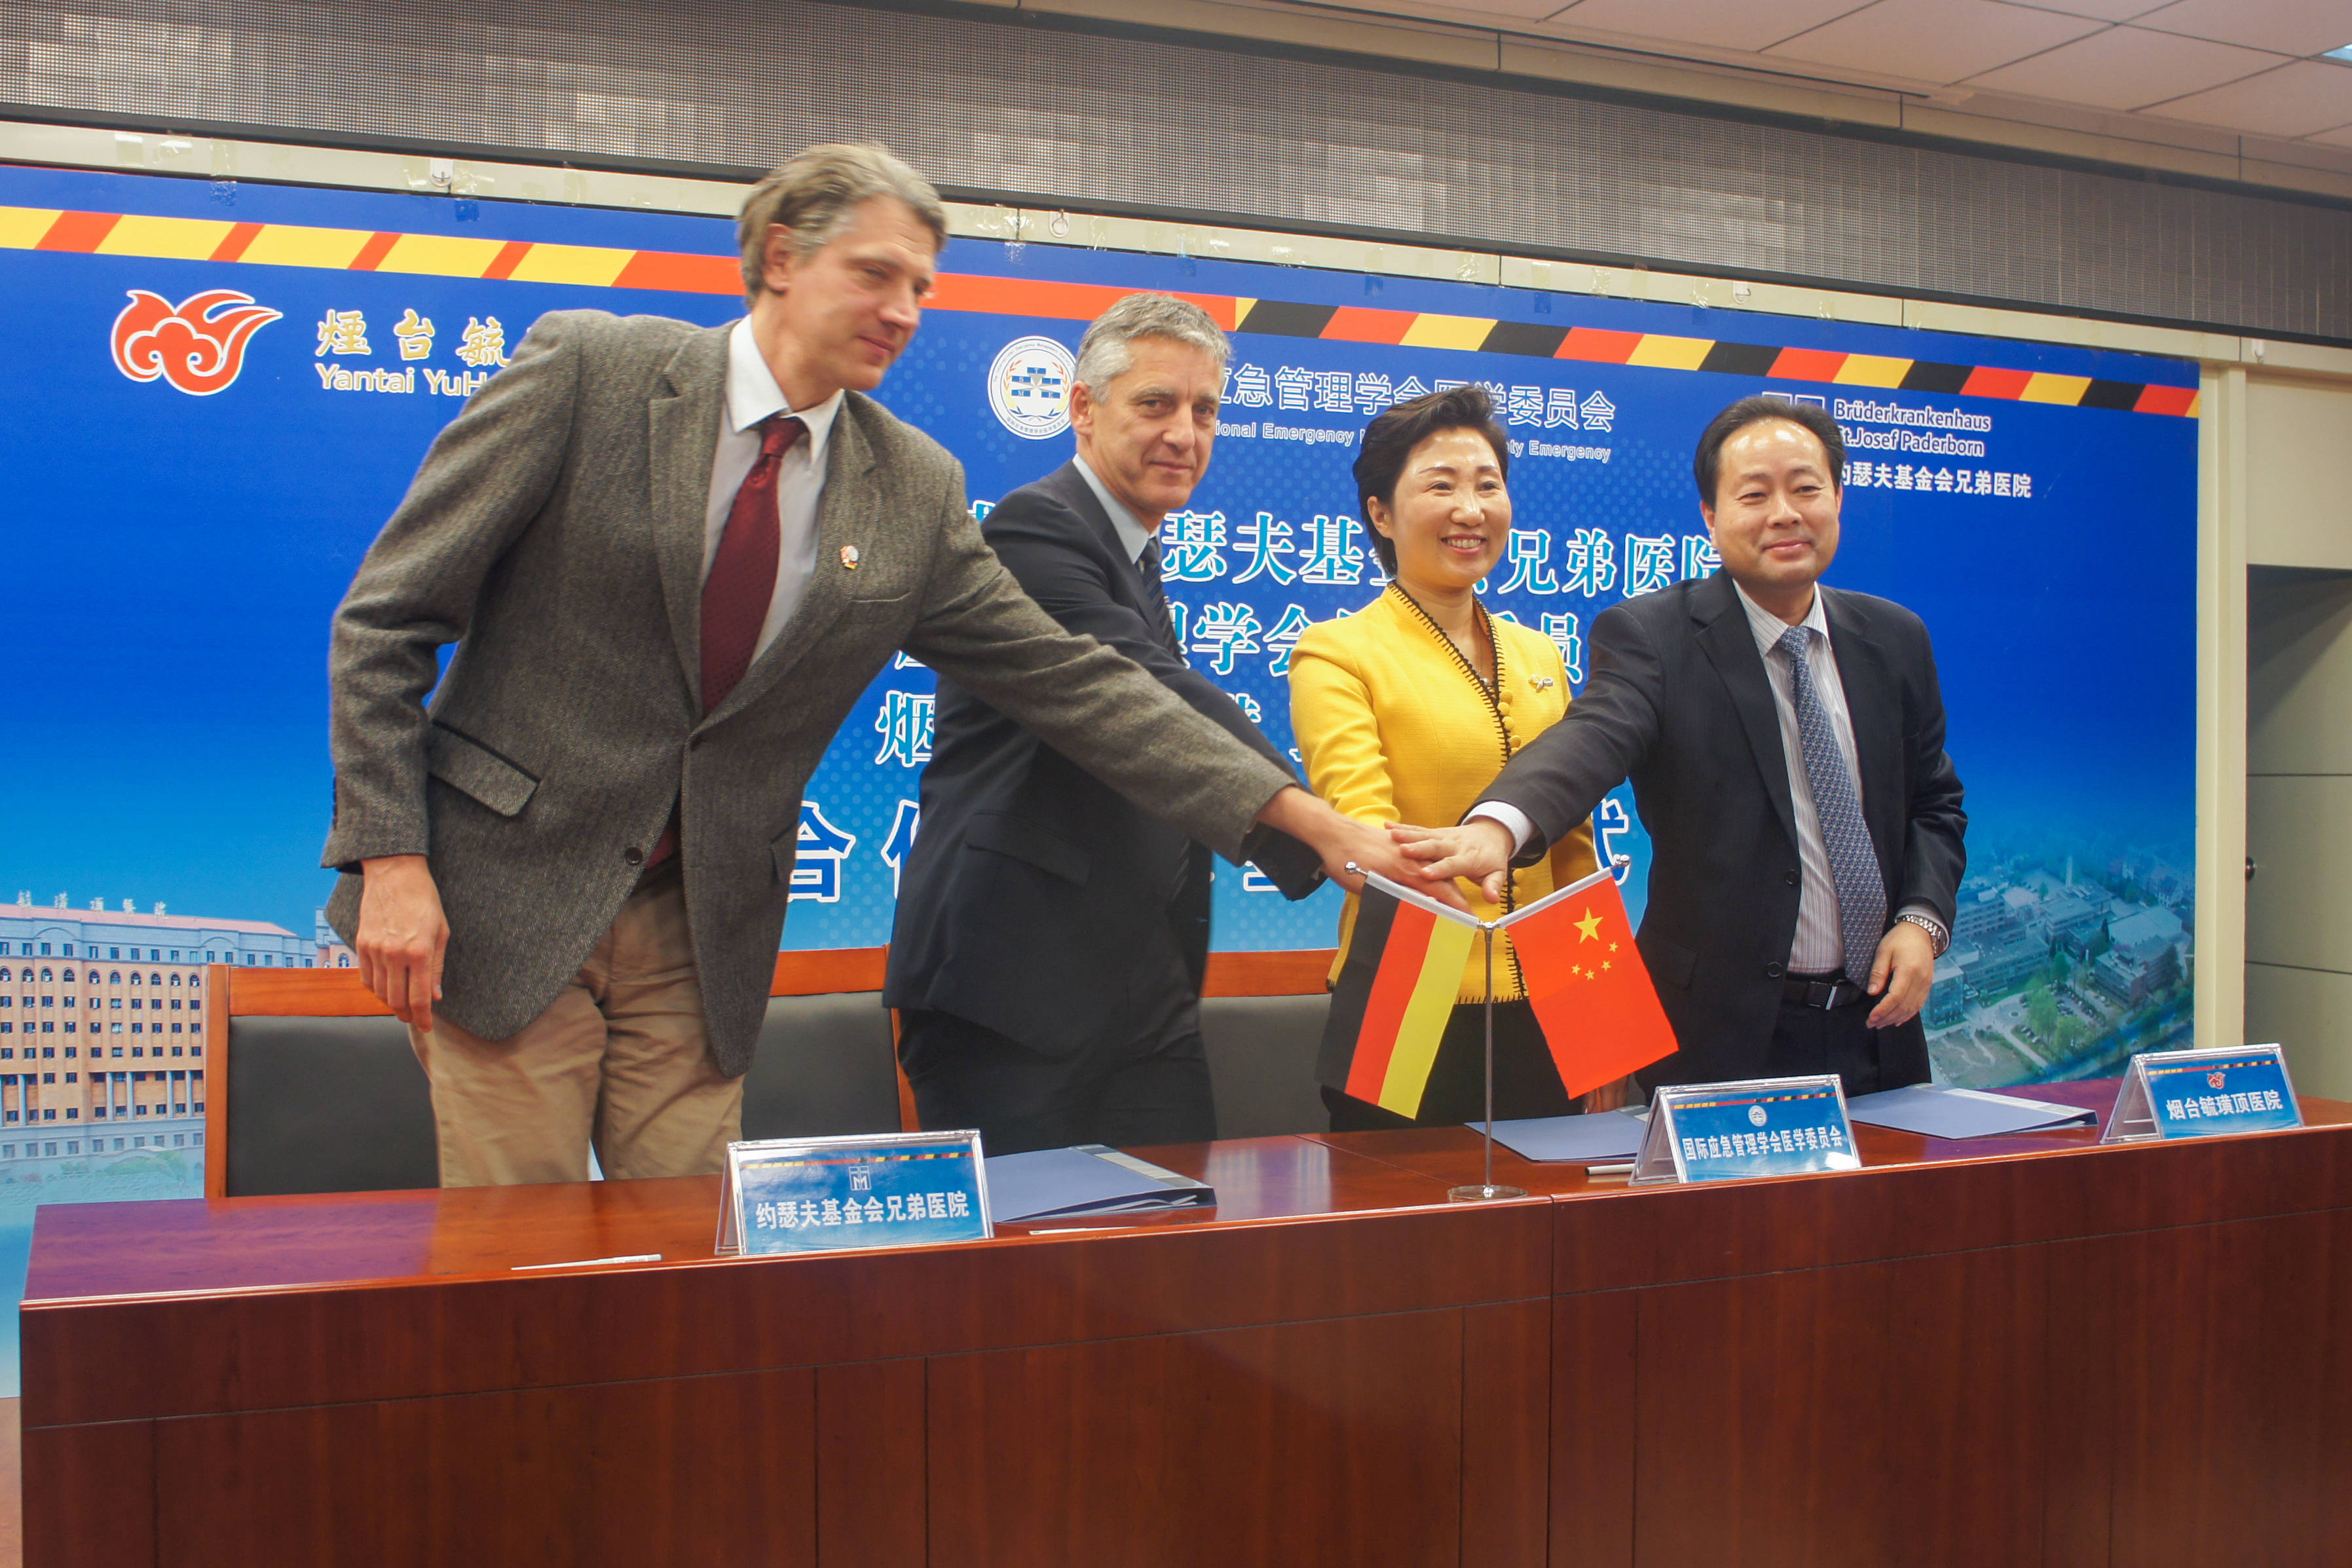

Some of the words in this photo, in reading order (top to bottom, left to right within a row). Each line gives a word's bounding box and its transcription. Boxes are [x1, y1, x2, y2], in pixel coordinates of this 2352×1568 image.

[315, 363, 415, 394] Yantai
[1833, 398, 1992, 433] Brüderkrankenhaus
[1262, 422, 1354, 447] Emergency
[1529, 439, 1611, 464] Emergency
[1900, 430, 1985, 458] Paderborn
[2166, 1089, 2283, 1120] 烟台毓璜顶医院
[1681, 1125, 1843, 1162] 国际应急管理学会医学委员会
[755, 1189, 970, 1230] 约瑟夫基金会兄弟医院
